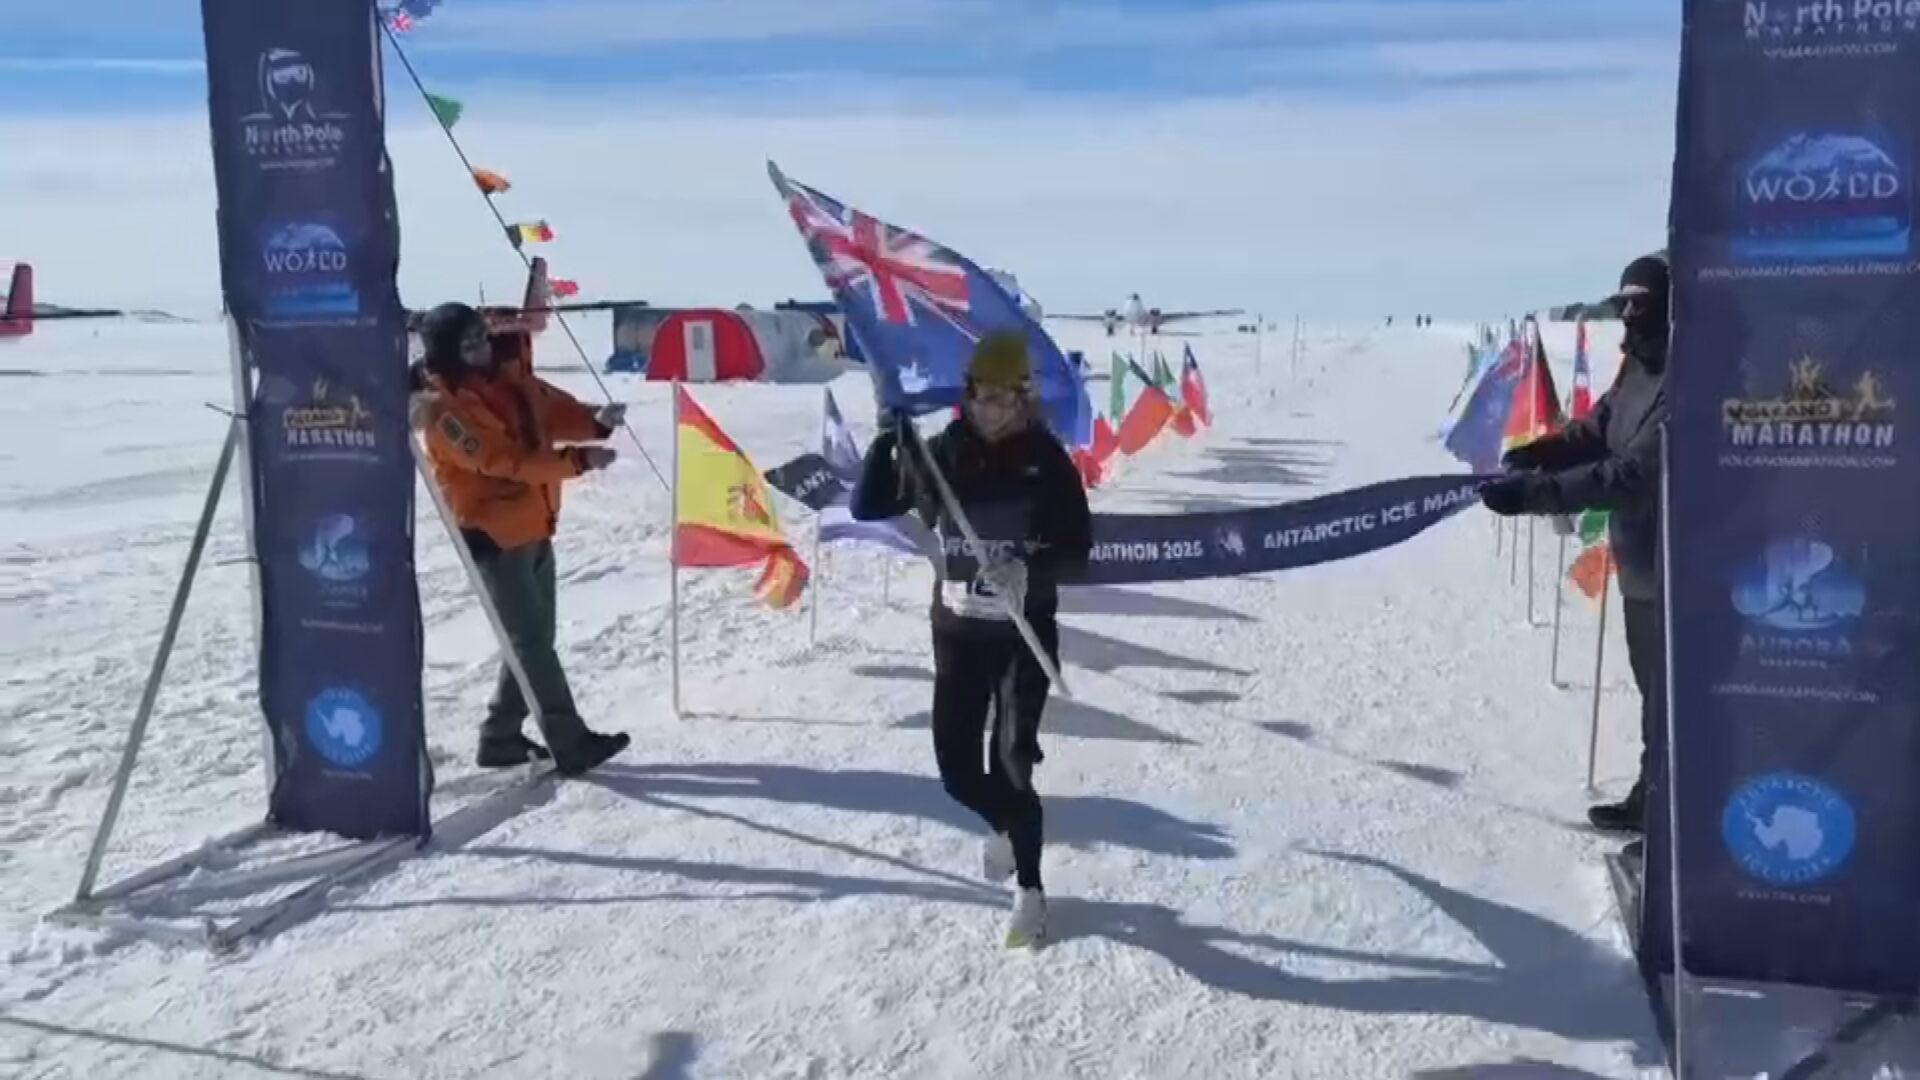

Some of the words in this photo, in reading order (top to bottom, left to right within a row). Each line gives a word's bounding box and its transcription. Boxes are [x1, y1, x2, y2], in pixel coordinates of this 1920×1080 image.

[302, 122, 344, 143] Pole
[287, 428, 376, 448] MARATHON
[1732, 422, 1895, 447] MARATHON
[1264, 513, 1376, 549] ANTARCTIC
[1381, 502, 1417, 526] ICE
